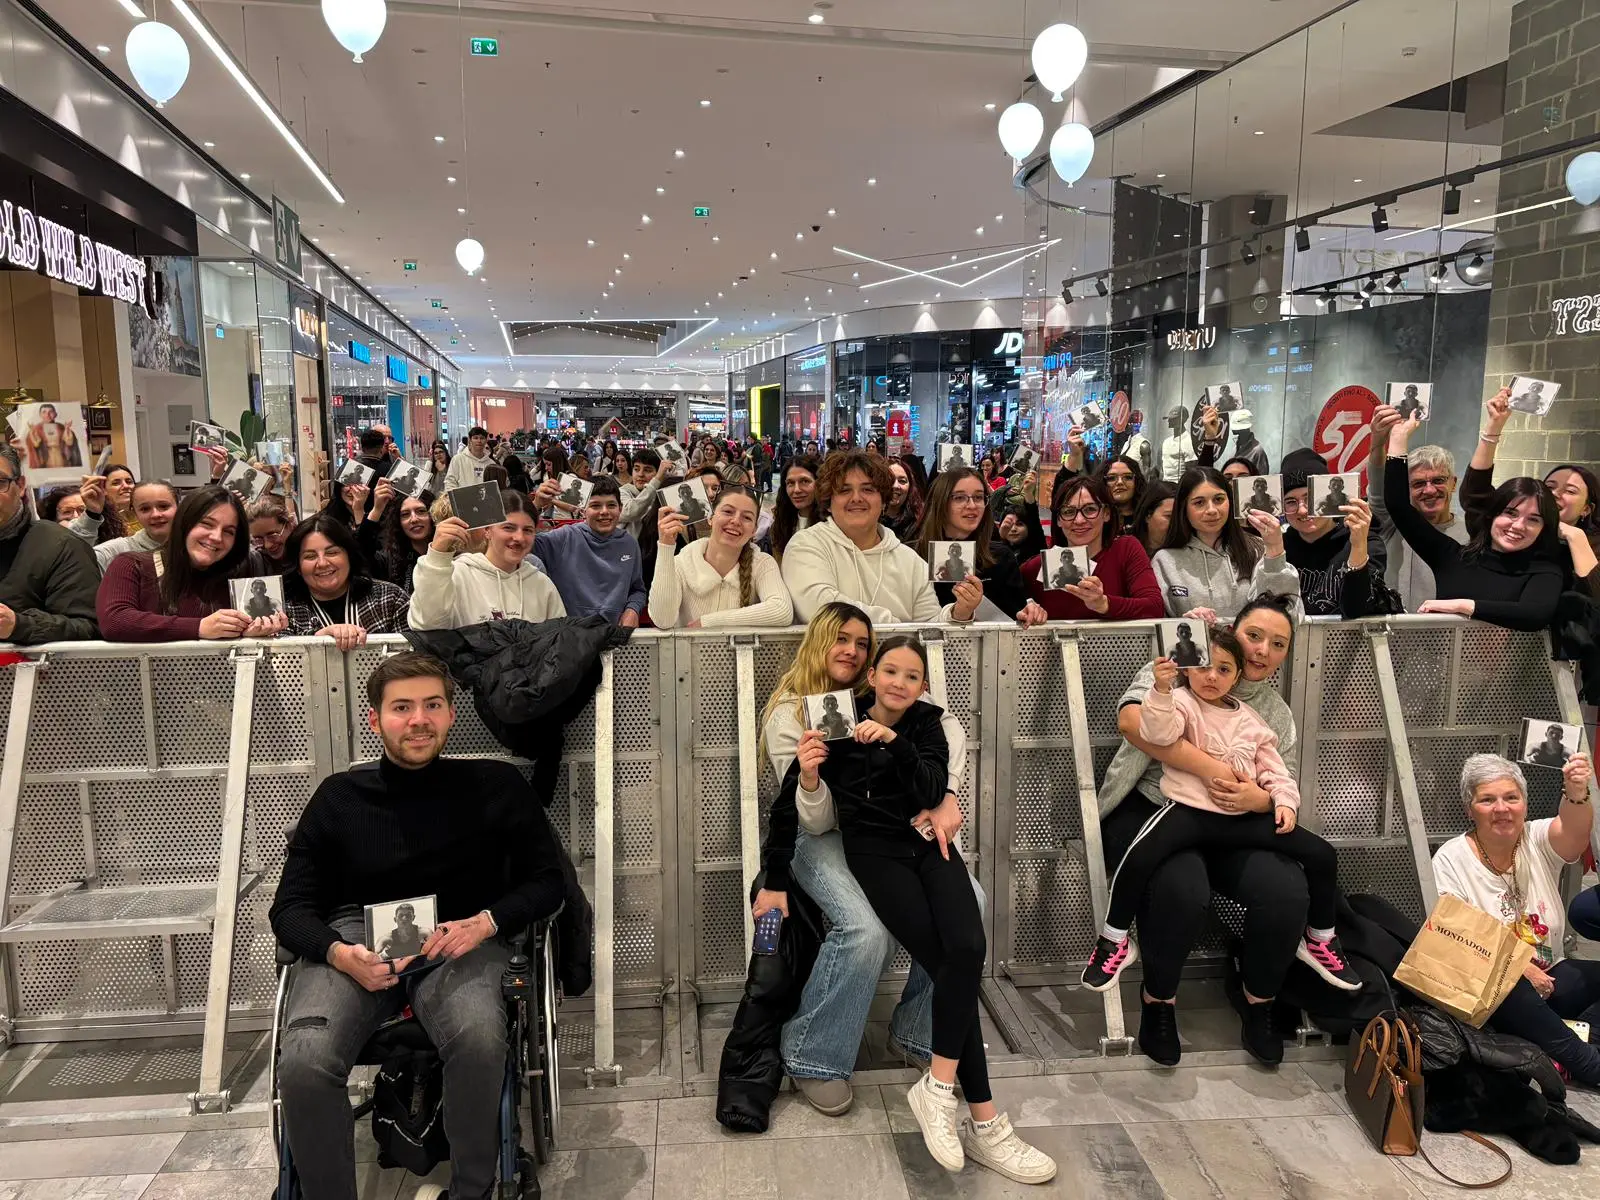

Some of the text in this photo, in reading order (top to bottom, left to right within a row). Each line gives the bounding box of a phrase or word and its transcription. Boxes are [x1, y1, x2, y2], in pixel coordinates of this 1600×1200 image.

[39, 216, 97, 290] WILD
[96, 242, 147, 307] WEST
[993, 332, 1025, 354] JD
[1434, 926, 1492, 958] MONDADORI
